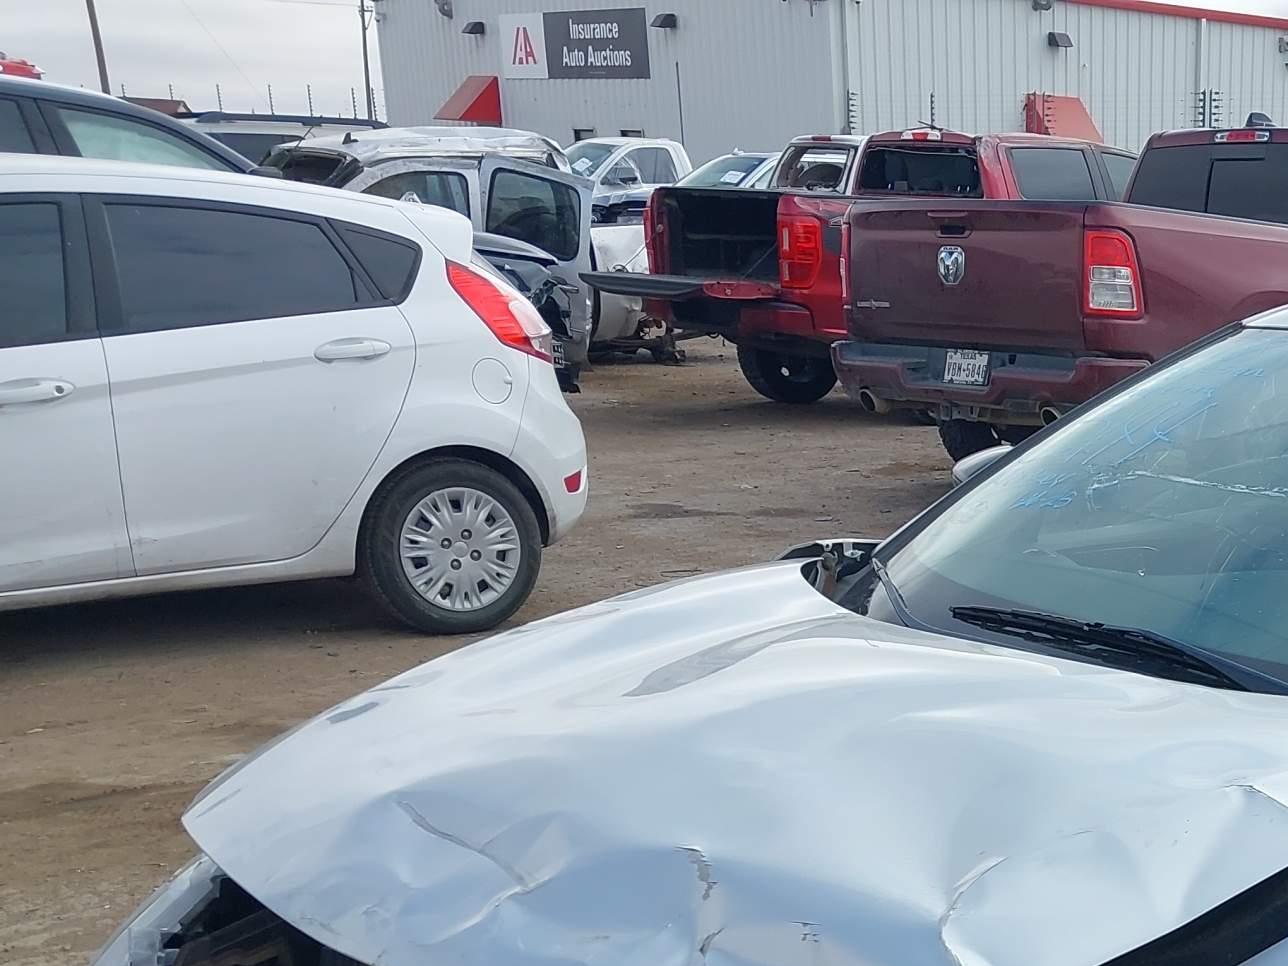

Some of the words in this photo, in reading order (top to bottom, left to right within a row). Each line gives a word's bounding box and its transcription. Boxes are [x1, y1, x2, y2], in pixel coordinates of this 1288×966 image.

[568, 18, 619, 40] Insurance
[562, 46, 585, 67] Auto
[587, 45, 632, 67] Auctions
